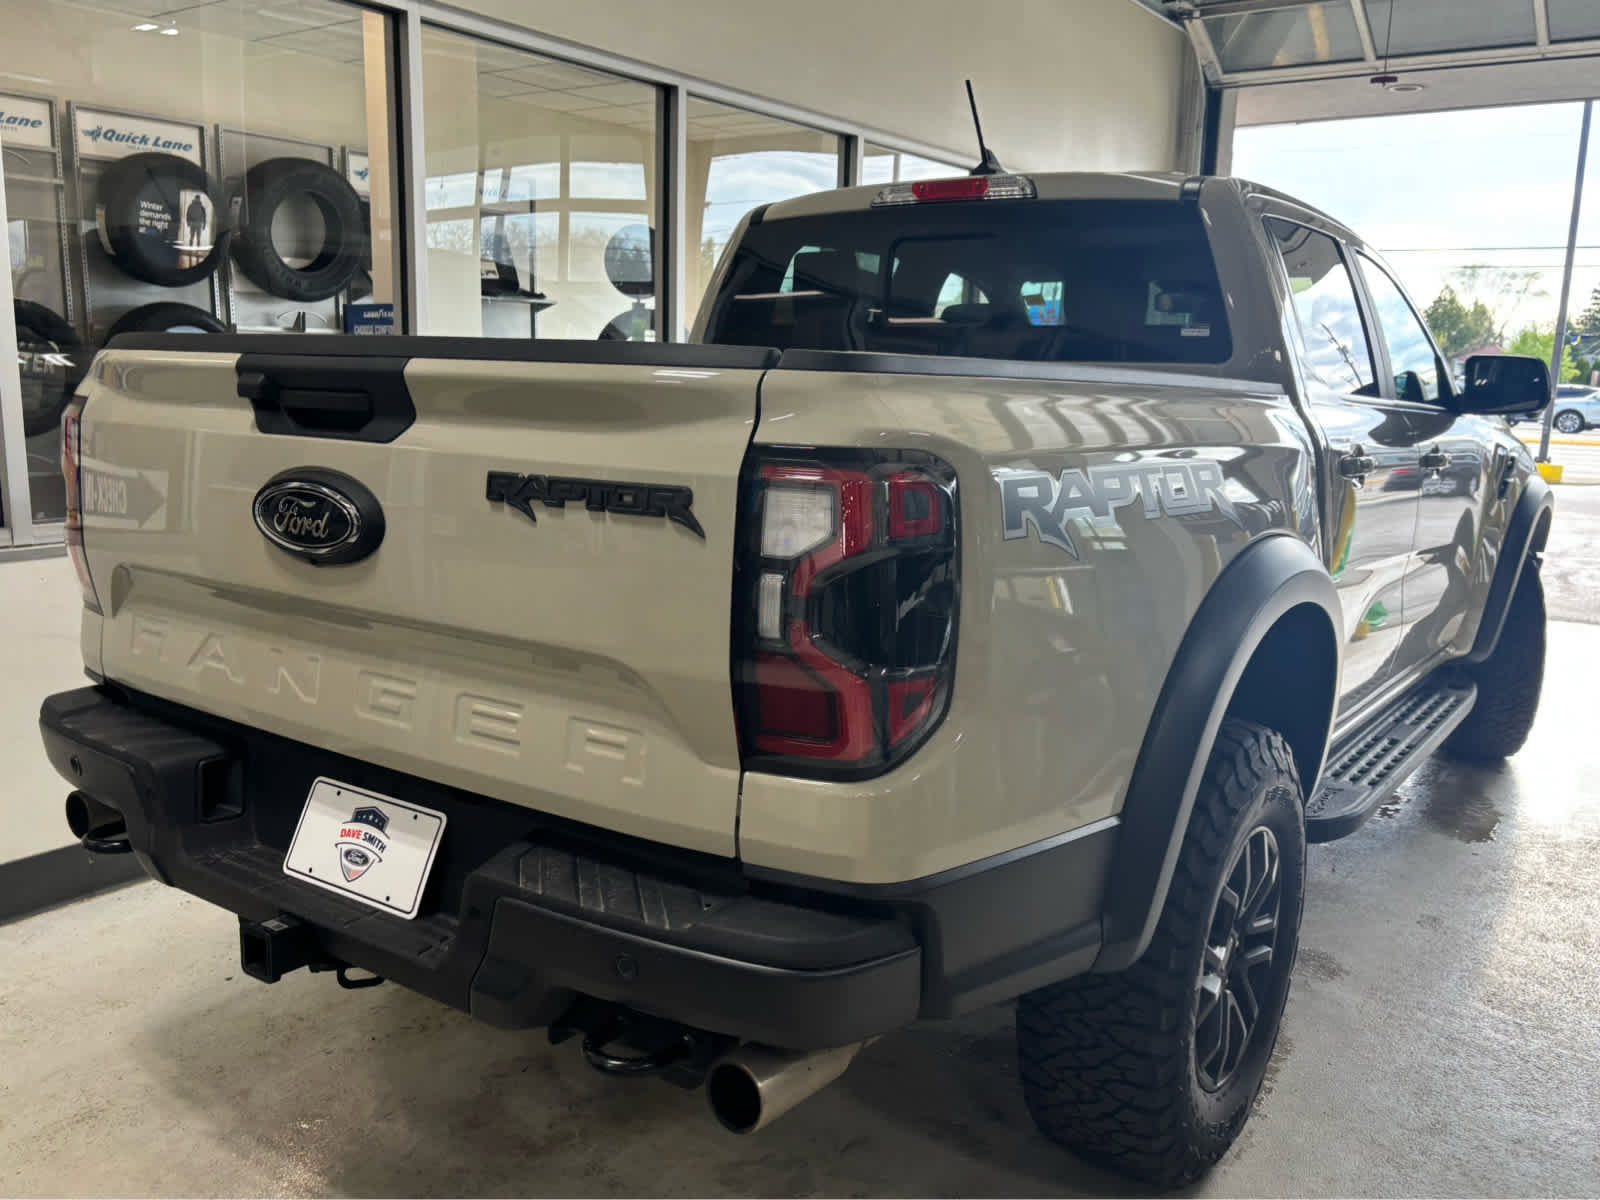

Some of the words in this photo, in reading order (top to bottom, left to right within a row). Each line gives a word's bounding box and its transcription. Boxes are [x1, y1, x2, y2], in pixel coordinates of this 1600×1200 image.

[102, 128, 150, 146] Quick
[152, 135, 193, 152] Lane
[140, 200, 163, 211] Winter
[273, 495, 331, 539] Ford
[486, 470, 706, 540] RAPTOR
[997, 461, 1248, 562] RAPTOR
[129, 612, 648, 788] RANGER
[340, 828, 363, 840] DAVE
[362, 832, 387, 854] SMITH
